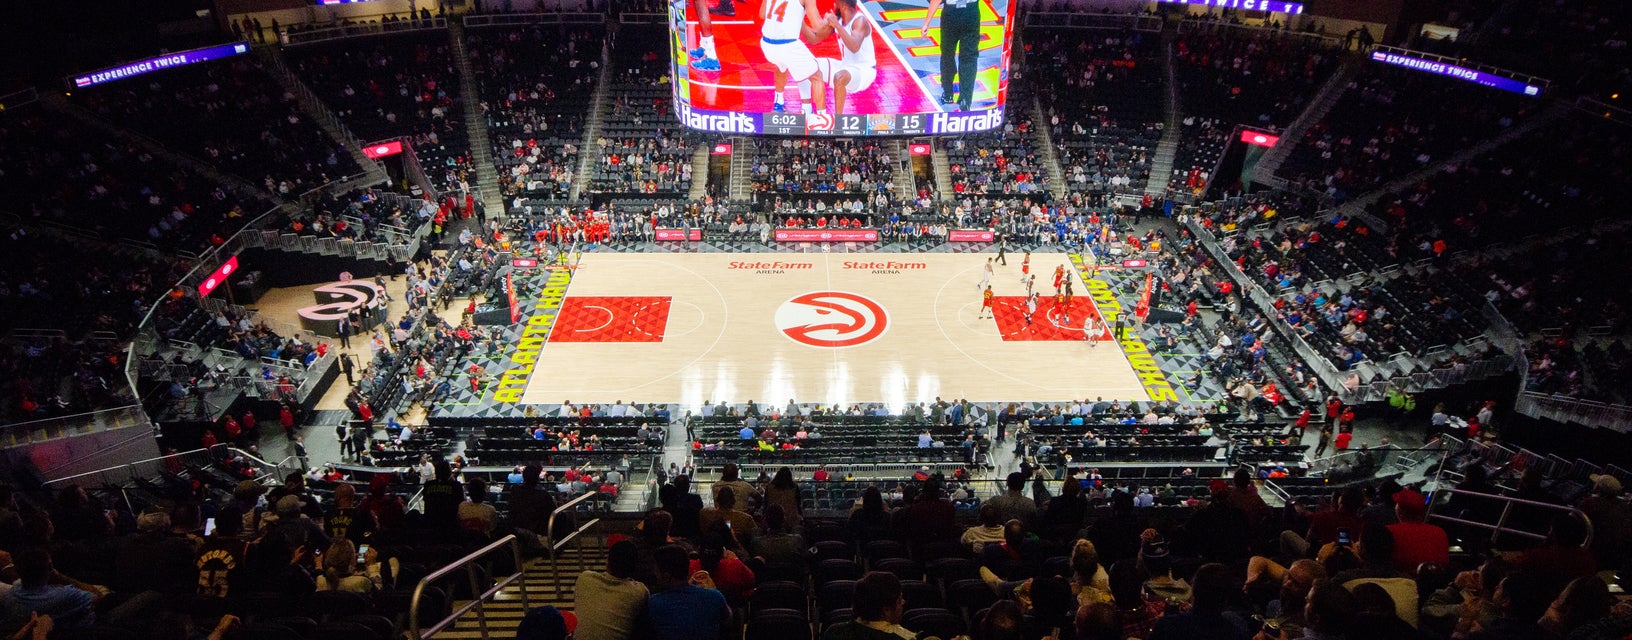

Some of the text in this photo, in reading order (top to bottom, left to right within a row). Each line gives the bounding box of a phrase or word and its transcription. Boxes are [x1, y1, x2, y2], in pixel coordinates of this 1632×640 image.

[767, 0, 788, 22] 14
[91, 61, 152, 83] EXPERIENCE
[154, 55, 187, 68] TWICE
[1386, 55, 1444, 72] EXPERIENCE
[1447, 67, 1478, 80] TWICE
[771, 115, 797, 125] 6:02
[841, 116, 859, 130] 12
[902, 116, 920, 129] 15
[728, 261, 813, 269] State Farm
[842, 261, 926, 269] State Farm
[492, 313, 555, 404] ATLANTA
